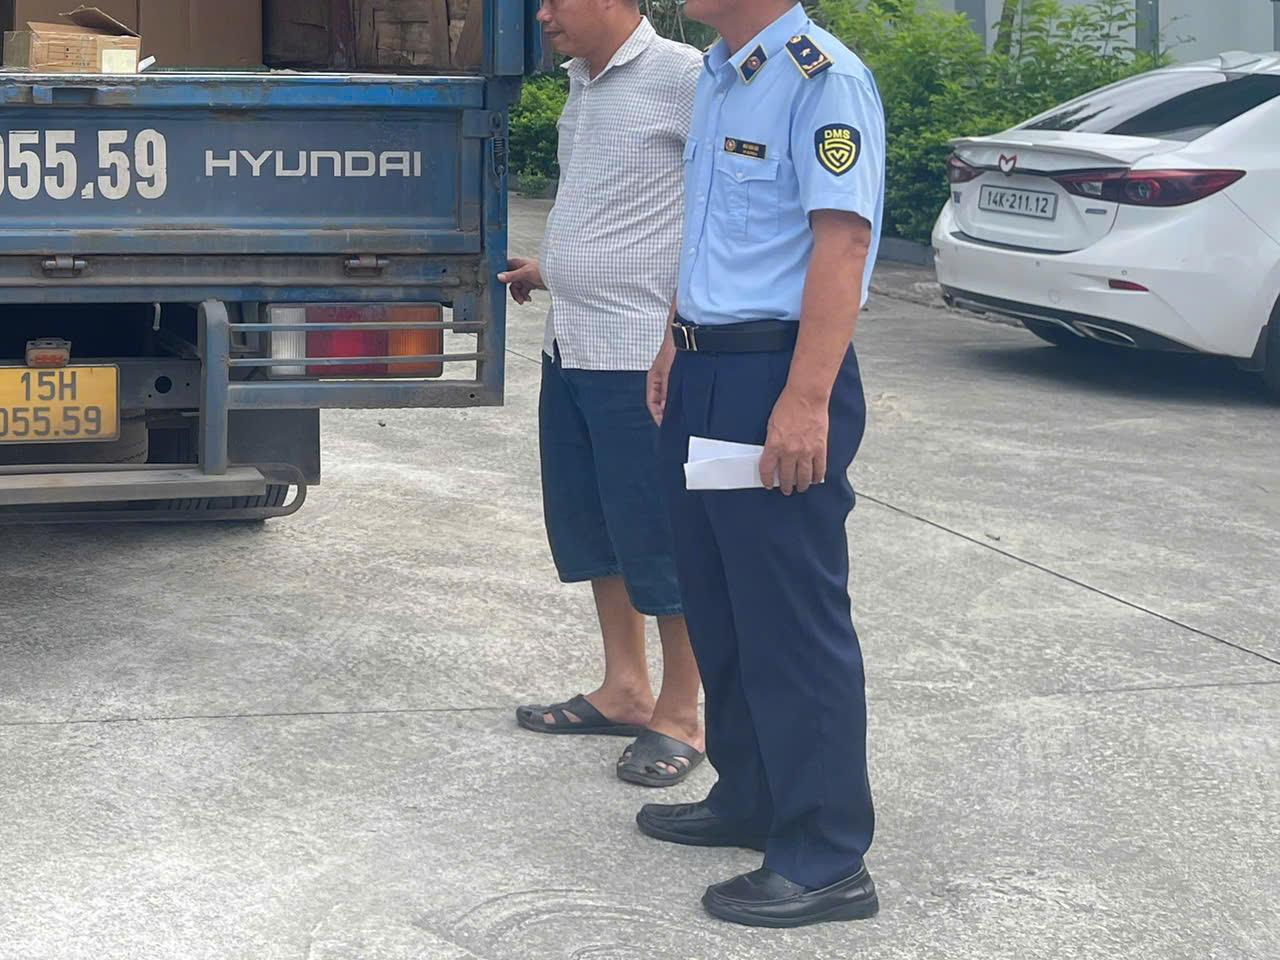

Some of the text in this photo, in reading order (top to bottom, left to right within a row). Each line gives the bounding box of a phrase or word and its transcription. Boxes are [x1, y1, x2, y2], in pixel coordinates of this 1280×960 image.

[824, 129, 850, 140] DMS
[205, 150, 422, 177] HYUNDAI
[987, 191, 1049, 214] 14K-211.12
[20, 371, 77, 401] 15H
